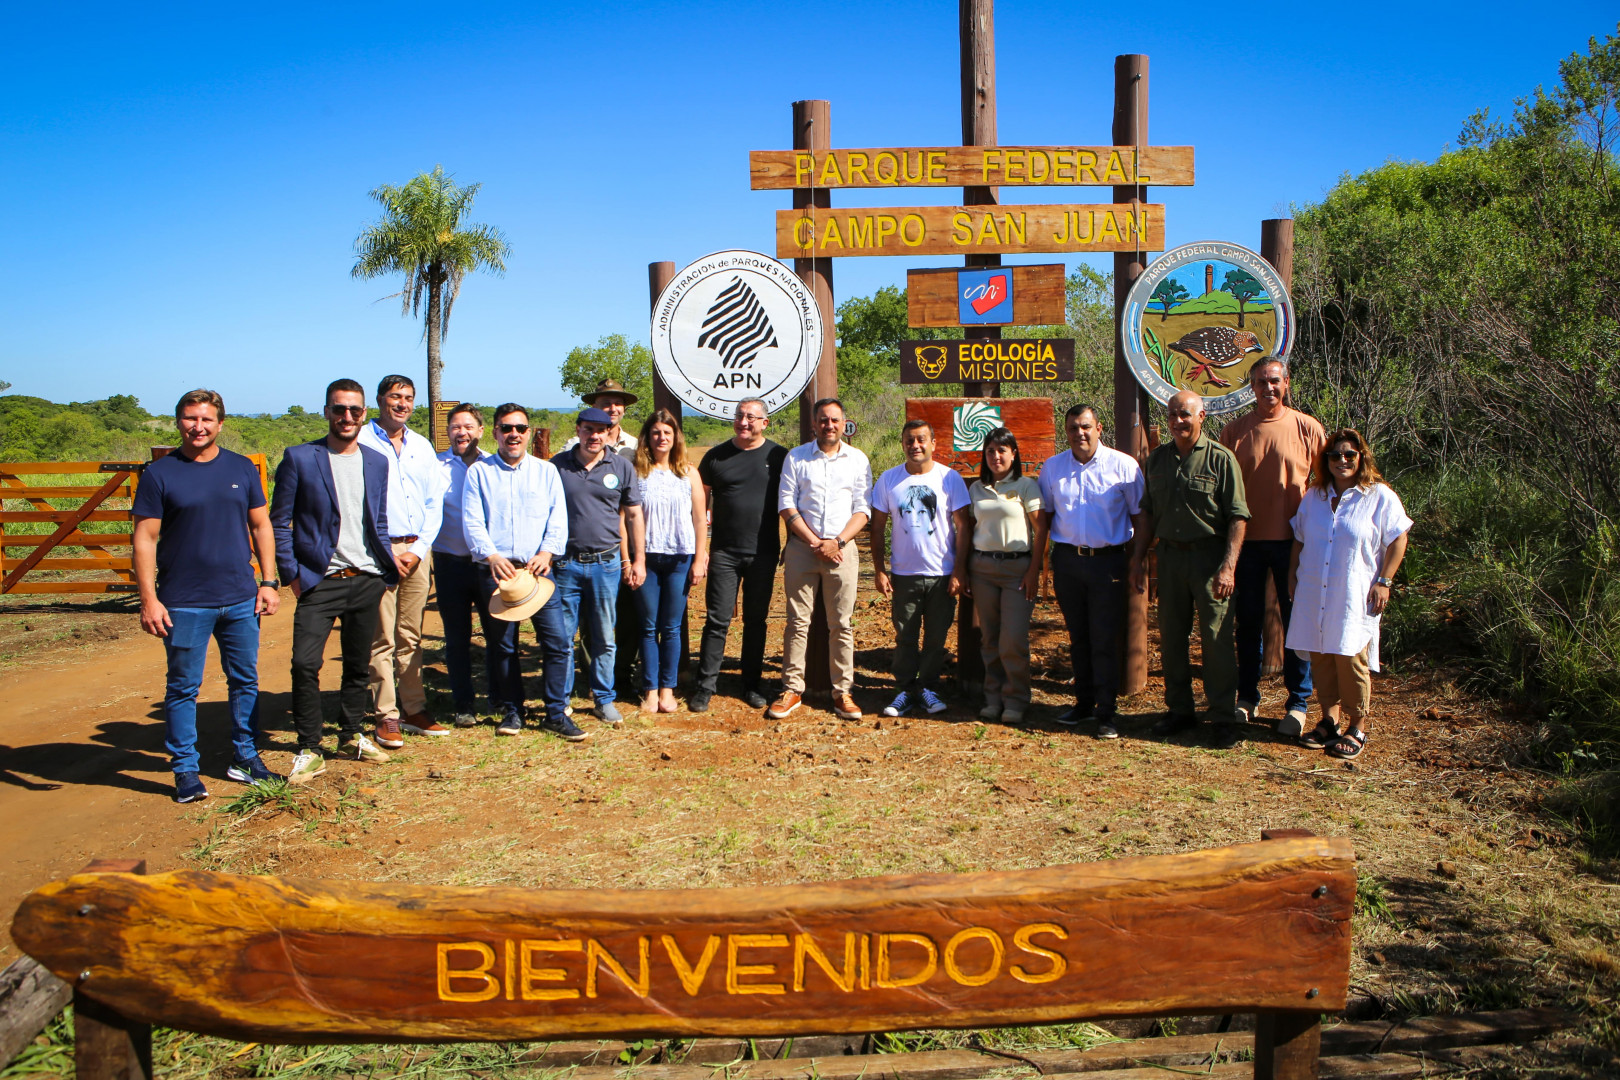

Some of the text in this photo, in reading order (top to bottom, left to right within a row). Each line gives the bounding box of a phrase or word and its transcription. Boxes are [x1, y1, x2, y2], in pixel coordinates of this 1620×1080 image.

[795, 149, 1150, 186] PARQUE FEDERAL
[793, 210, 1148, 250] CAMPO SAN JUAN
[1145, 246, 1282, 299] PARQUE FEDERAL CAMPO SAN JUAN
[659, 257, 815, 332] ADMINISTRACION de PARQUES NACIONALES
[958, 340, 1056, 362] ECOLOGÍA
[713, 372, 762, 389] APN
[959, 362, 1058, 381] MISIONES
[1139, 369, 1156, 386] APN
[1203, 399, 1237, 410] SIONES
[685, 389, 789, 415] ARGENA
[436, 922, 1069, 1003] BIENVENIDOS
